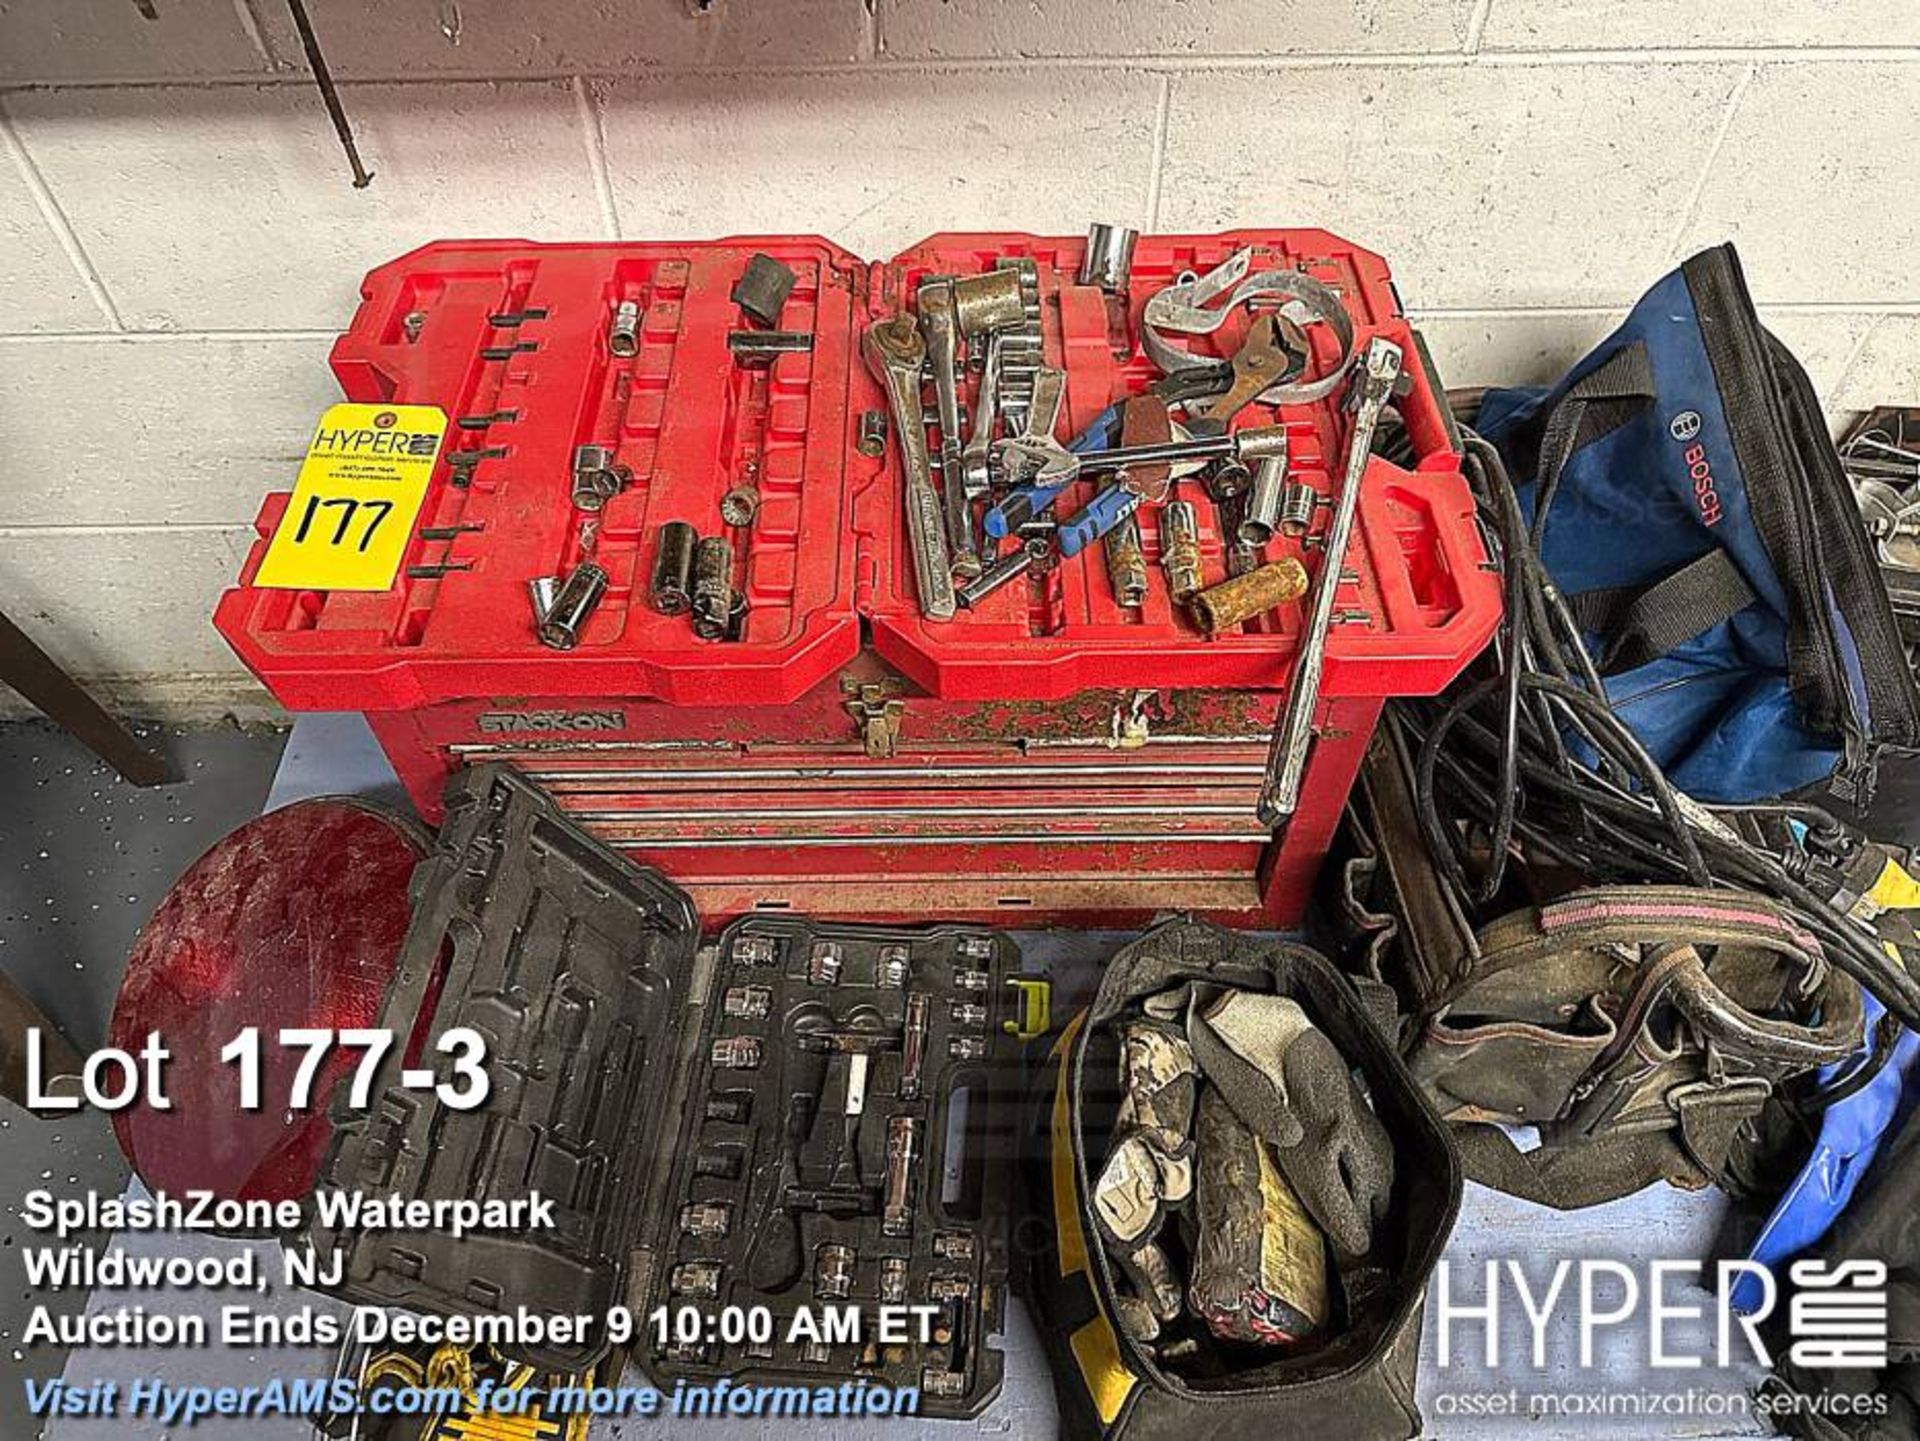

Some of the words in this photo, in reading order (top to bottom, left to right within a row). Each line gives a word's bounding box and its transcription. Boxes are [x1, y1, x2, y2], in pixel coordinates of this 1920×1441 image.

[313, 429, 410, 454] HYPER
[1685, 444, 1723, 528] BOSCH
[294, 494, 394, 553] 177
